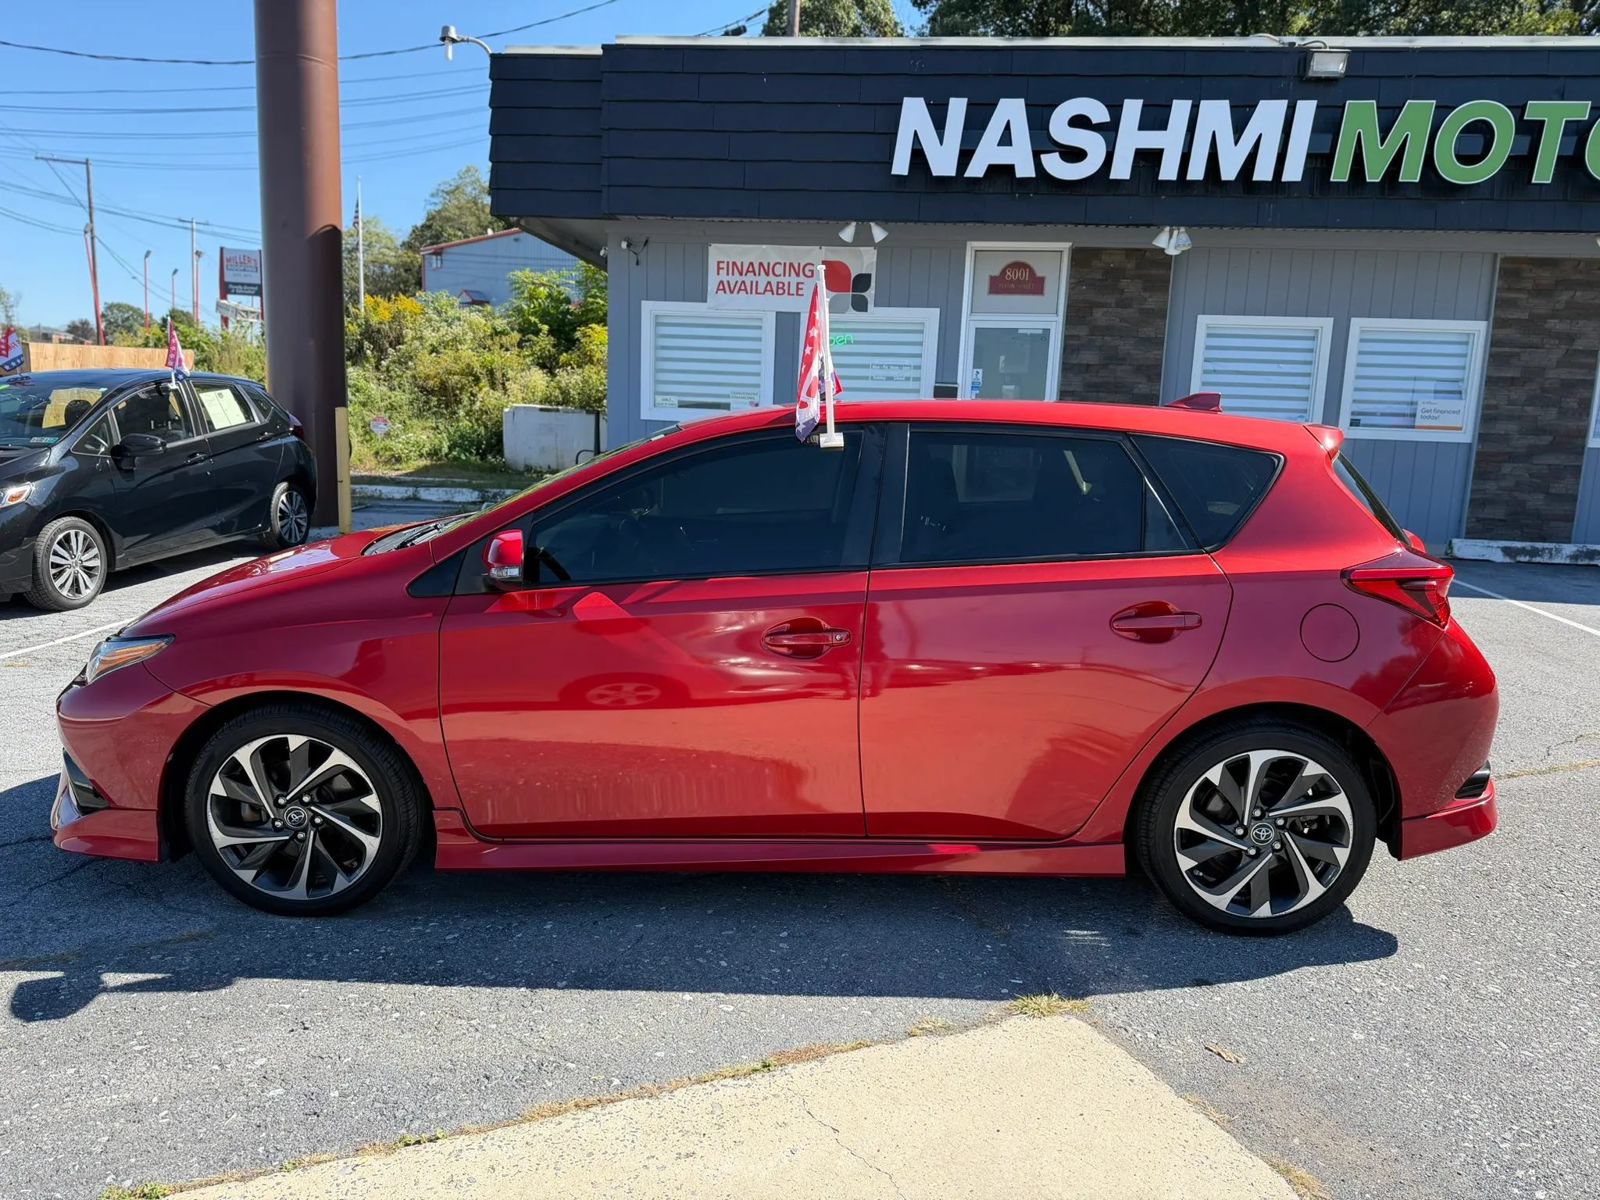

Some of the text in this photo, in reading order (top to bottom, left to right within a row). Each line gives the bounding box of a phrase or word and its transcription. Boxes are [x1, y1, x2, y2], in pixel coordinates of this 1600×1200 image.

[891, 97, 1600, 184] NASHMI MOT
[716, 260, 815, 278] FINANCING
[1005, 267, 1029, 281] 8001
[715, 279, 805, 297] AVAILABLE
